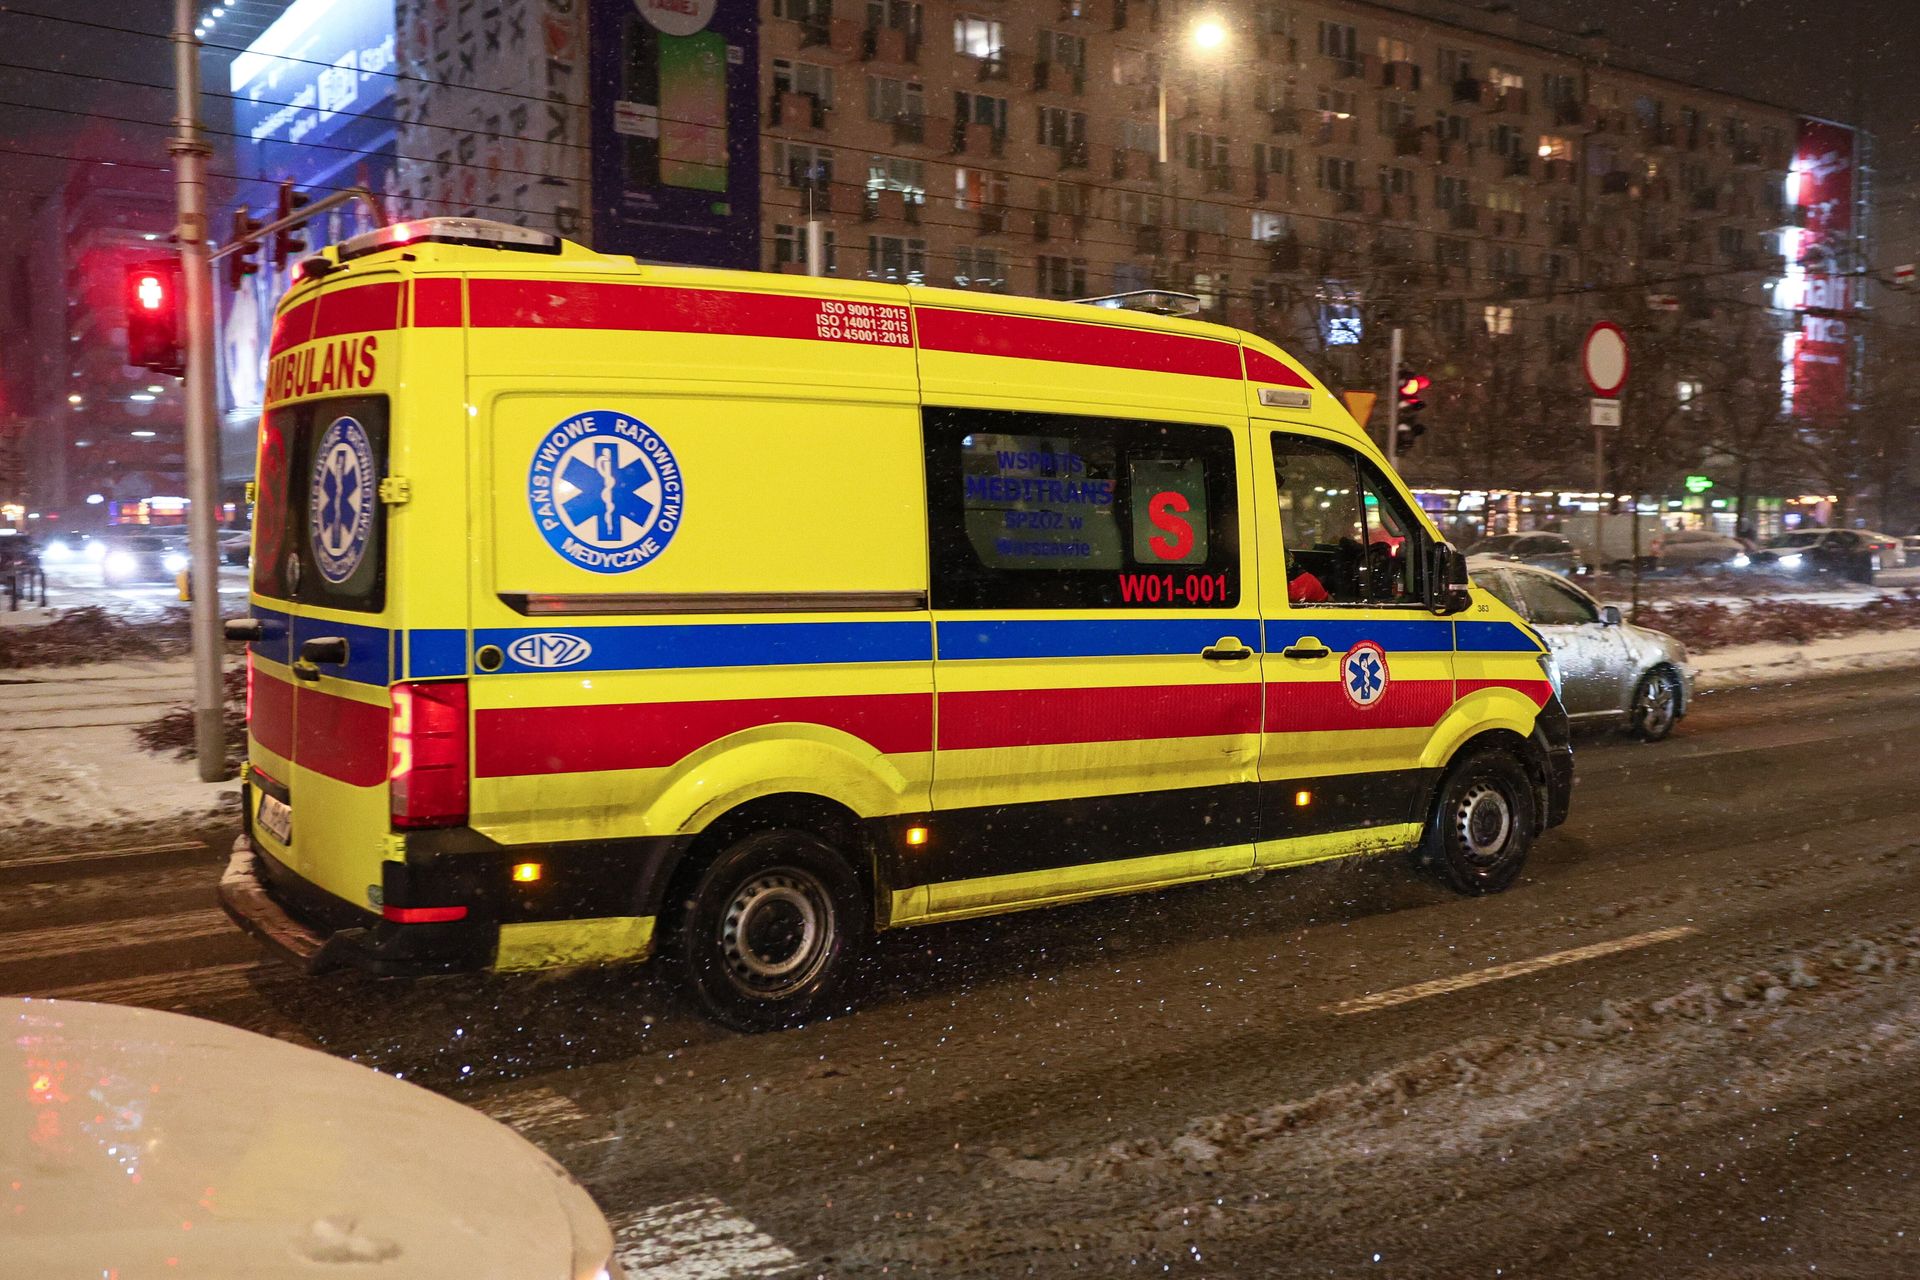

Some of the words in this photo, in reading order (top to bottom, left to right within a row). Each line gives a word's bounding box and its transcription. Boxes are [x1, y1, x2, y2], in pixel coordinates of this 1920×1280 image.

[815, 313, 840, 326] ISO
[842, 316, 909, 332] 14001:2015
[821, 301, 845, 314] ISO
[847, 304, 907, 320] 9001:2015
[817, 326, 841, 339] ISO
[843, 328, 910, 344] 45001:2018
[614, 418, 681, 533] RATOWNICTWO
[966, 476, 1114, 505] MEDITRANS
[1148, 491, 1194, 560] S
[561, 537, 661, 568] MEDYCZNE
[1119, 574, 1227, 602] W01-001
